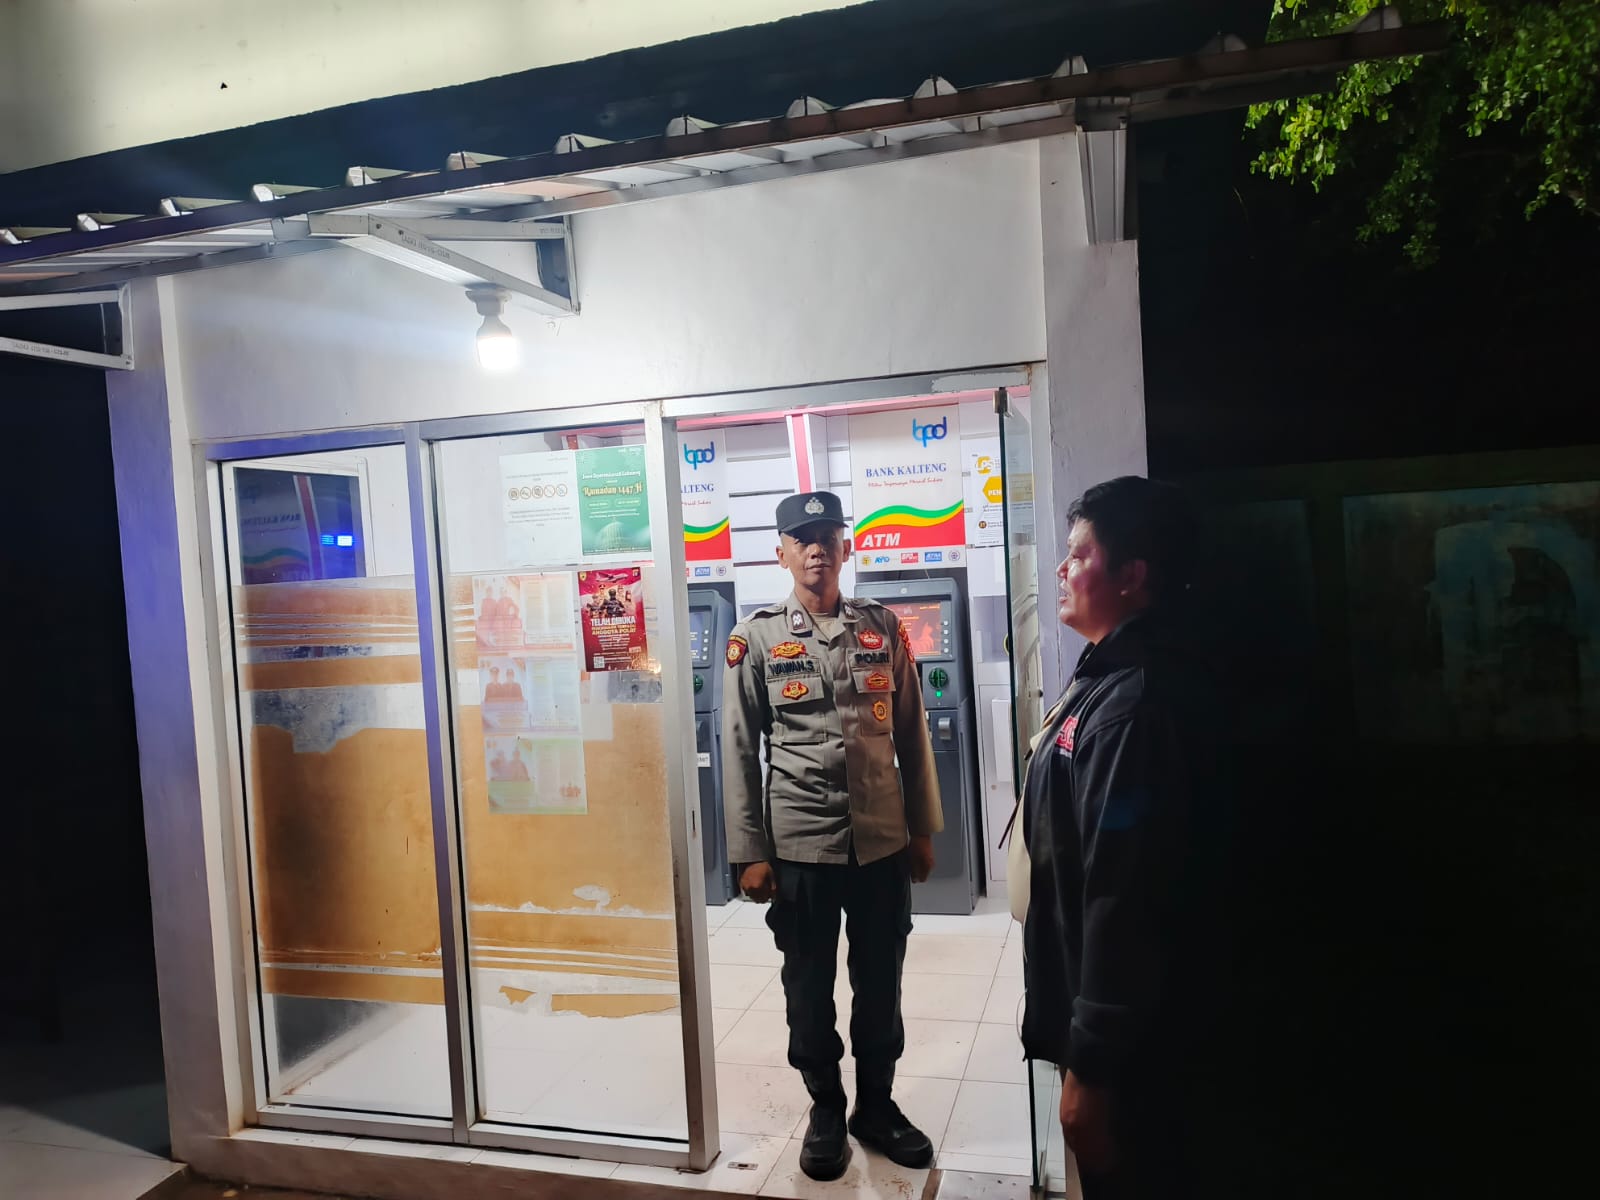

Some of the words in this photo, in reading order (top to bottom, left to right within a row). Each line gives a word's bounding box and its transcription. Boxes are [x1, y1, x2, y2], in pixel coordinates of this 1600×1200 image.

[912, 416, 947, 448] bpd
[684, 441, 715, 470] bpd
[866, 466, 894, 478] BANK
[897, 462, 947, 476] KALTENG
[681, 483, 714, 493] LTENG
[861, 533, 901, 548] ATM
[855, 652, 889, 664] POLRI
